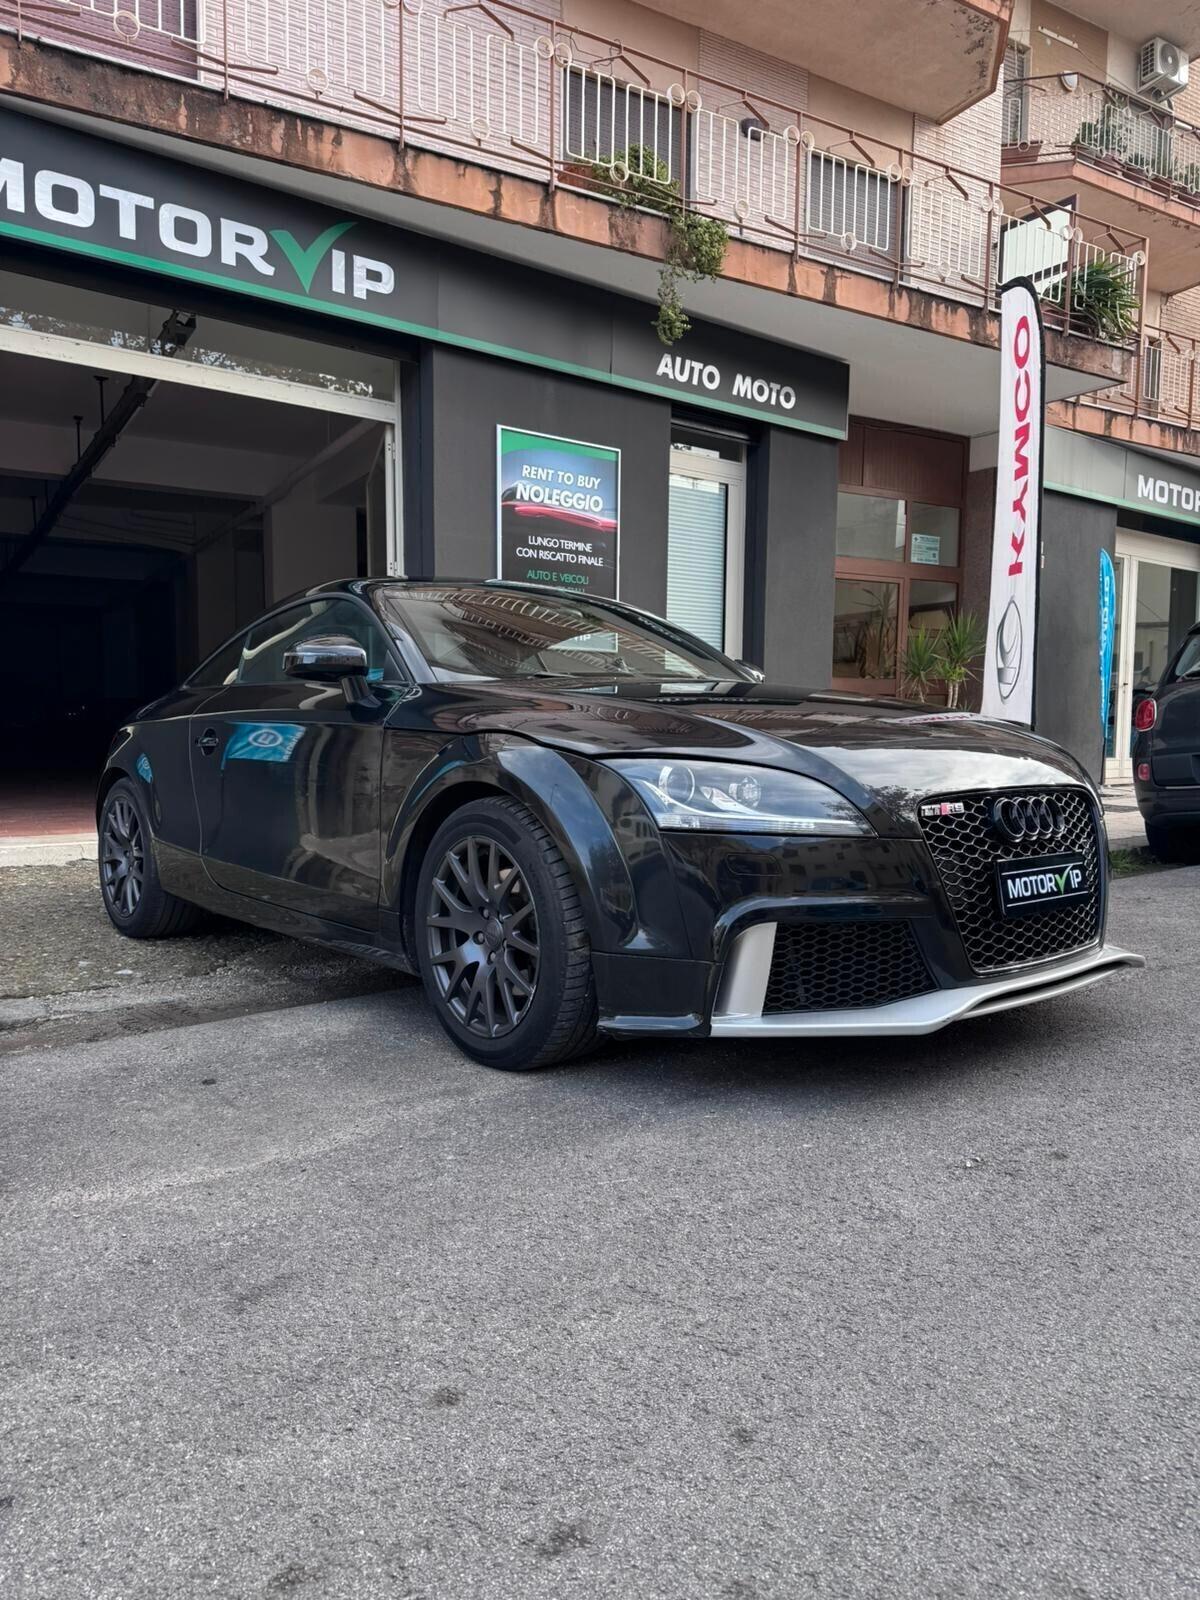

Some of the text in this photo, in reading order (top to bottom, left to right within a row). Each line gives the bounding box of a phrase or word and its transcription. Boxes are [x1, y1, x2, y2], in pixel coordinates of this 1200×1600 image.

[656, 353, 796, 409] AUTO MOTO
[522, 464, 601, 490] RENT TO BUY
[516, 483, 604, 513] NOLEGGIO
[516, 547, 604, 567] CON RISCATTO FINALE
[528, 535, 593, 553] LUNGO TERMINE
[527, 569, 589, 585] AUTO E VEICOLI
[1007, 864, 1082, 899] MOTORVIP
